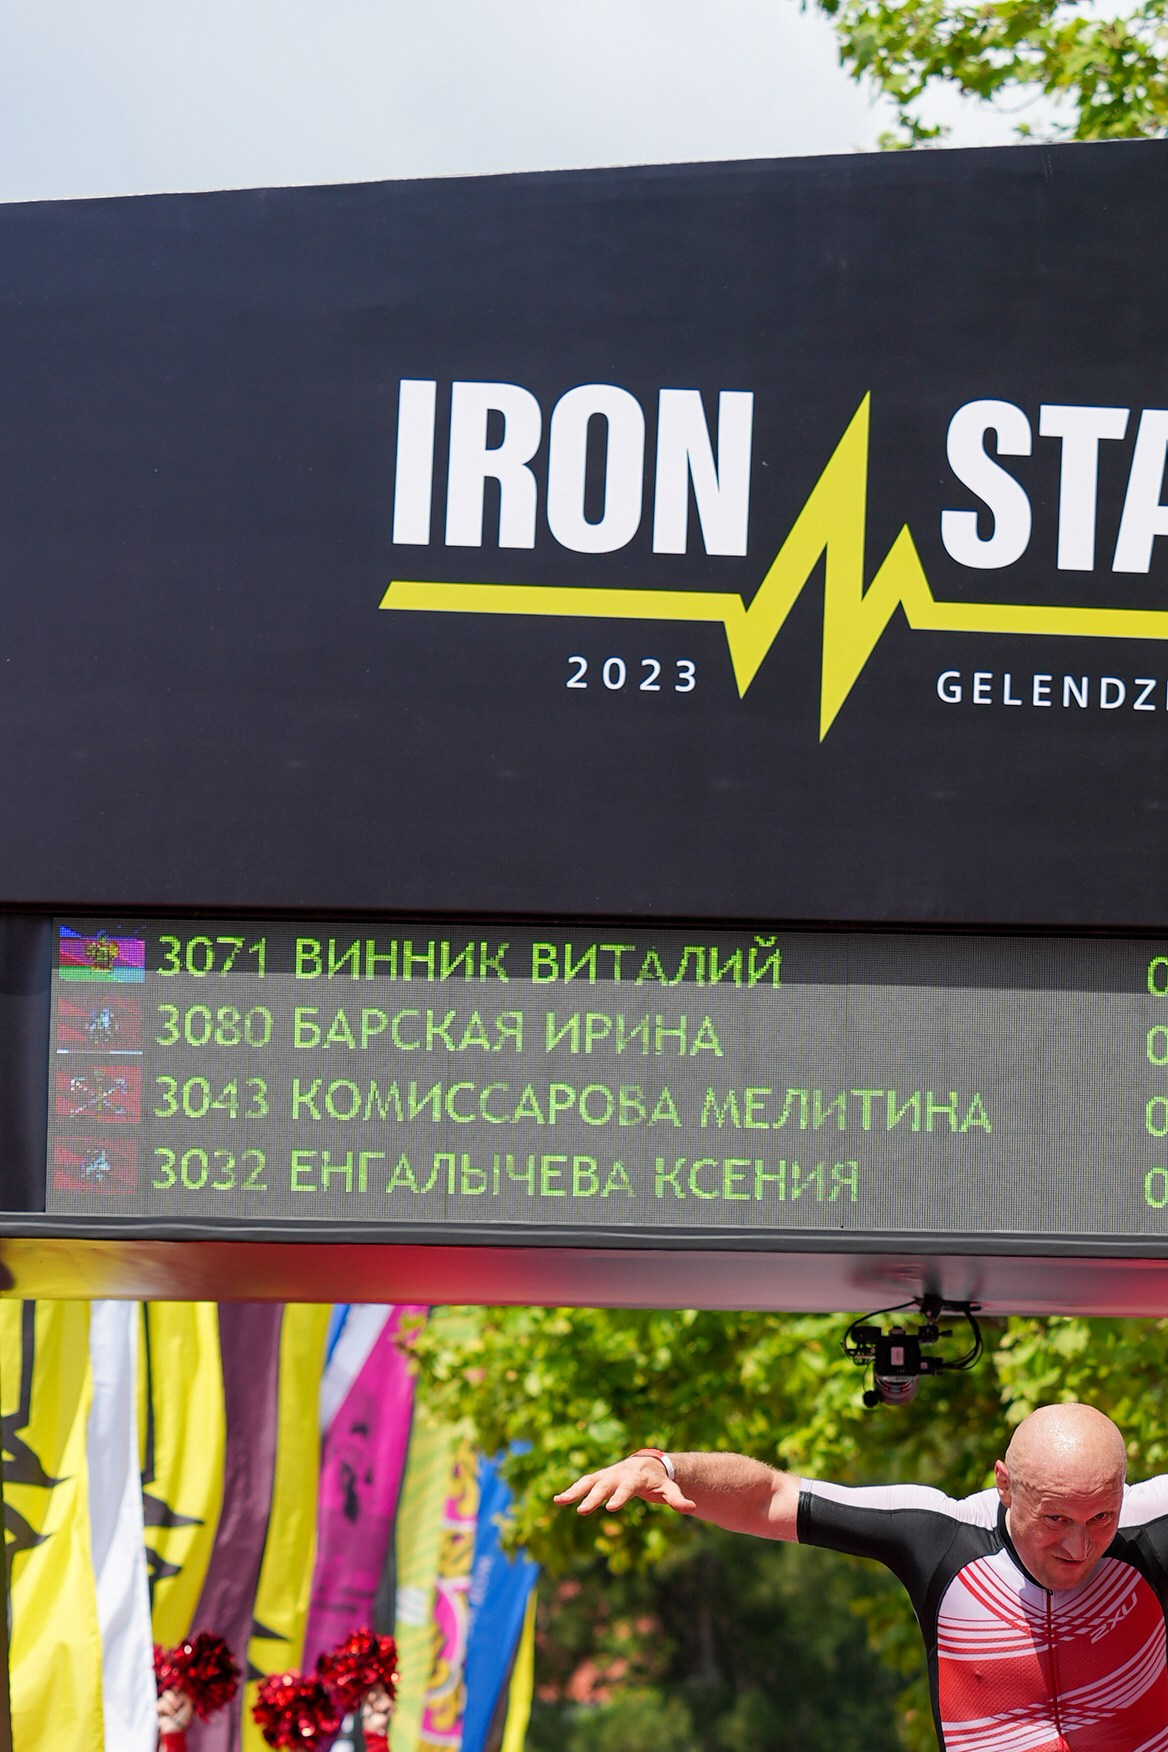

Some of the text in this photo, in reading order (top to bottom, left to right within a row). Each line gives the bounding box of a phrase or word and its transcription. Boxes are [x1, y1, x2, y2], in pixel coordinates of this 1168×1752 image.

[393, 379, 753, 556] IRON
[566, 656, 697, 693] 2023
[157, 936, 268, 977] 3071
[295, 938, 509, 980] ВИННИК
[531, 935, 782, 987] ВИТАЛИЙ
[154, 1004, 273, 1046] 3080
[293, 1007, 523, 1050] БАРСКАЯ
[546, 1012, 723, 1056] ИРИНА
[153, 1076, 270, 1120] 3043
[292, 1078, 681, 1127] КОМИССАРОВА
[701, 1087, 992, 1132] МЕЛИТИНА
[152, 1147, 268, 1190] 3032
[290, 1149, 635, 1197] ЕНГАЛЫЧЕВА
[655, 1157, 859, 1201] КСЕНИЯ
